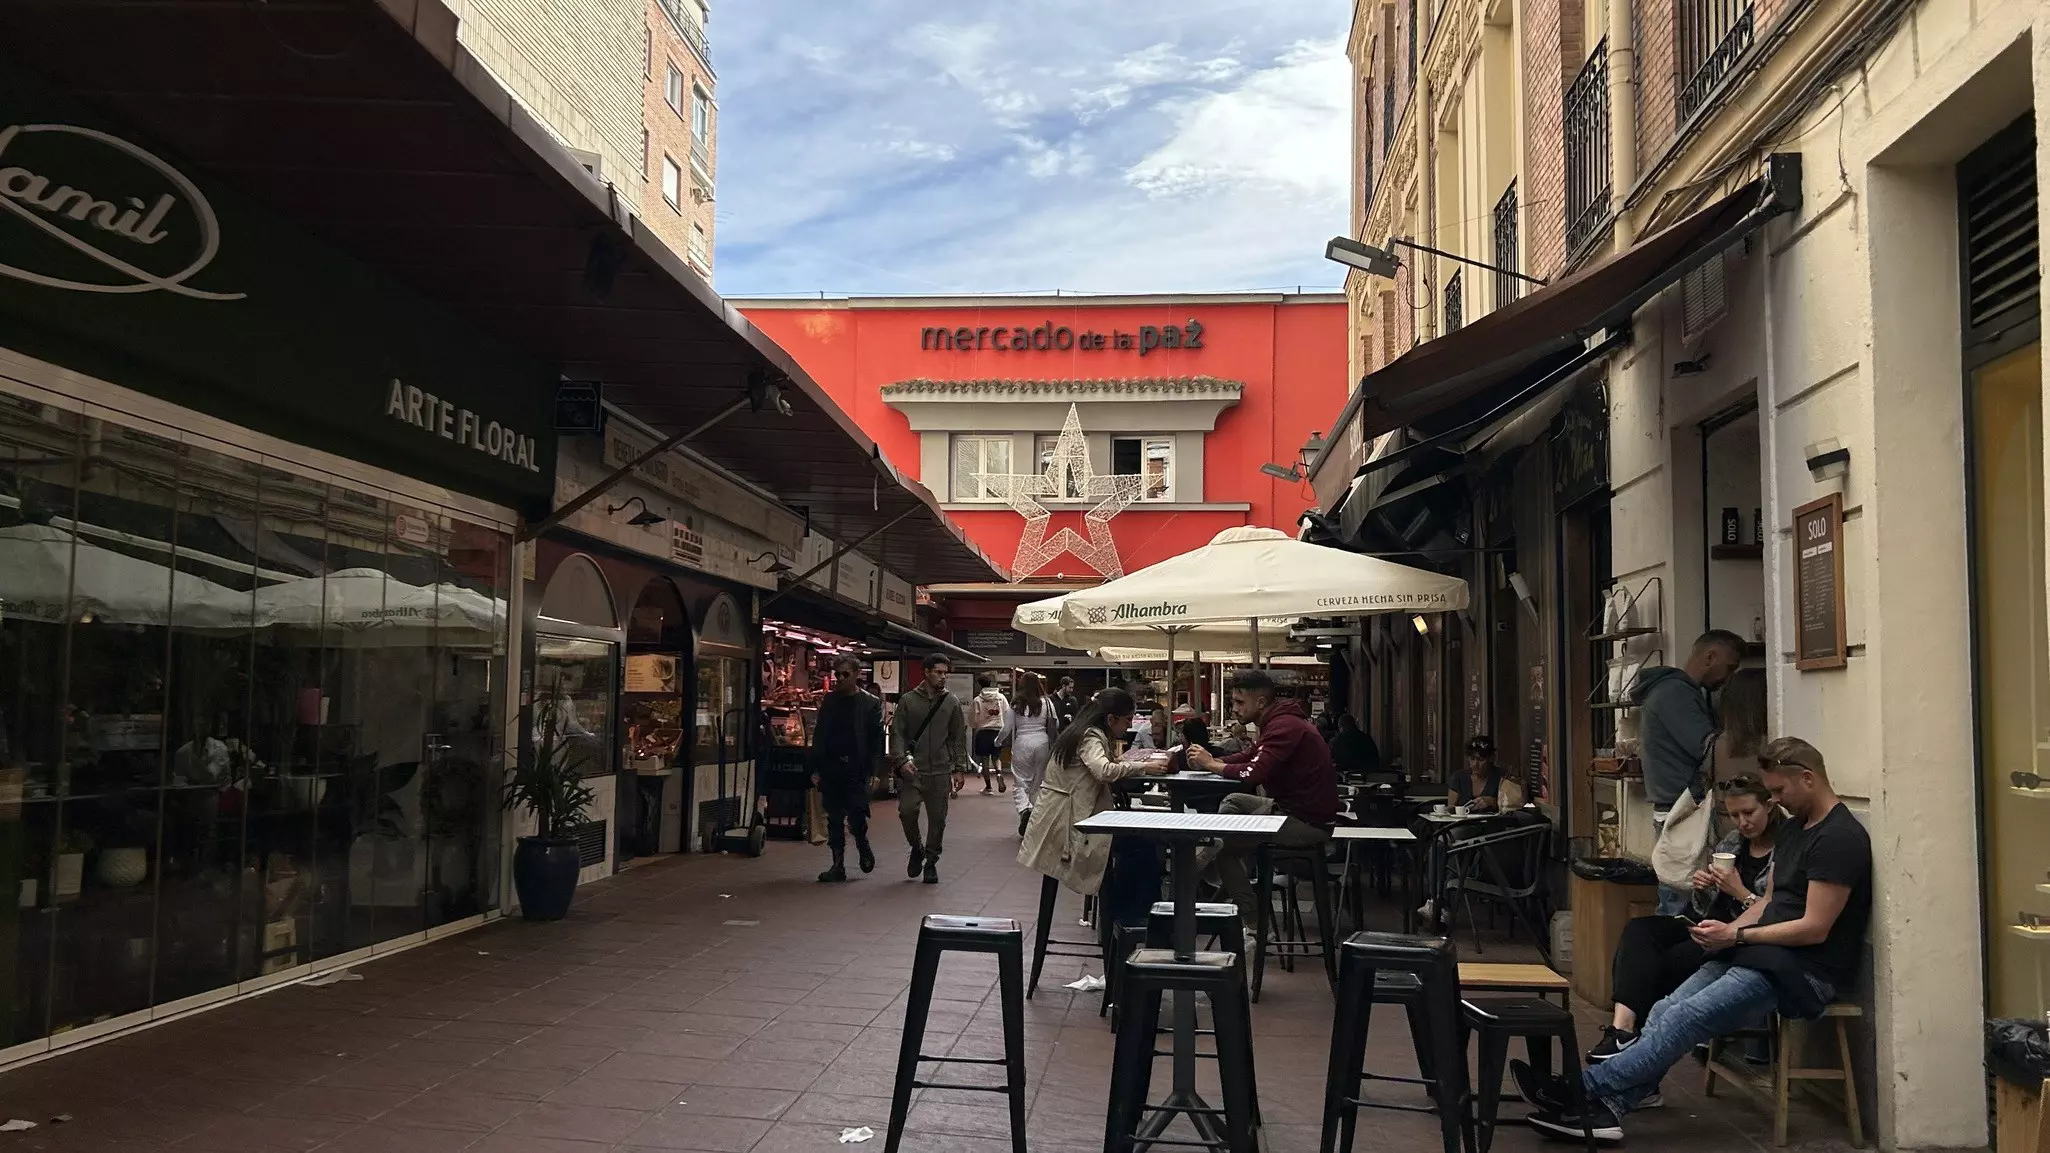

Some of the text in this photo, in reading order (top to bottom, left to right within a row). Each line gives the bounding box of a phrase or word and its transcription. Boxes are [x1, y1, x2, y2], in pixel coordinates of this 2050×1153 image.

[921, 320, 1075, 352] mercado
[1078, 328, 1106, 351] de
[1113, 328, 1133, 351] la
[386, 378, 455, 440] ARTE
[456, 409, 540, 473] FLORAL
[1808, 518, 1826, 540] SOLO
[1317, 597, 1359, 607] CERVEZA
[1397, 594, 1413, 603] SIN
[1417, 593, 1447, 603] PRISA
[1111, 601, 1187, 622] Alhambra
